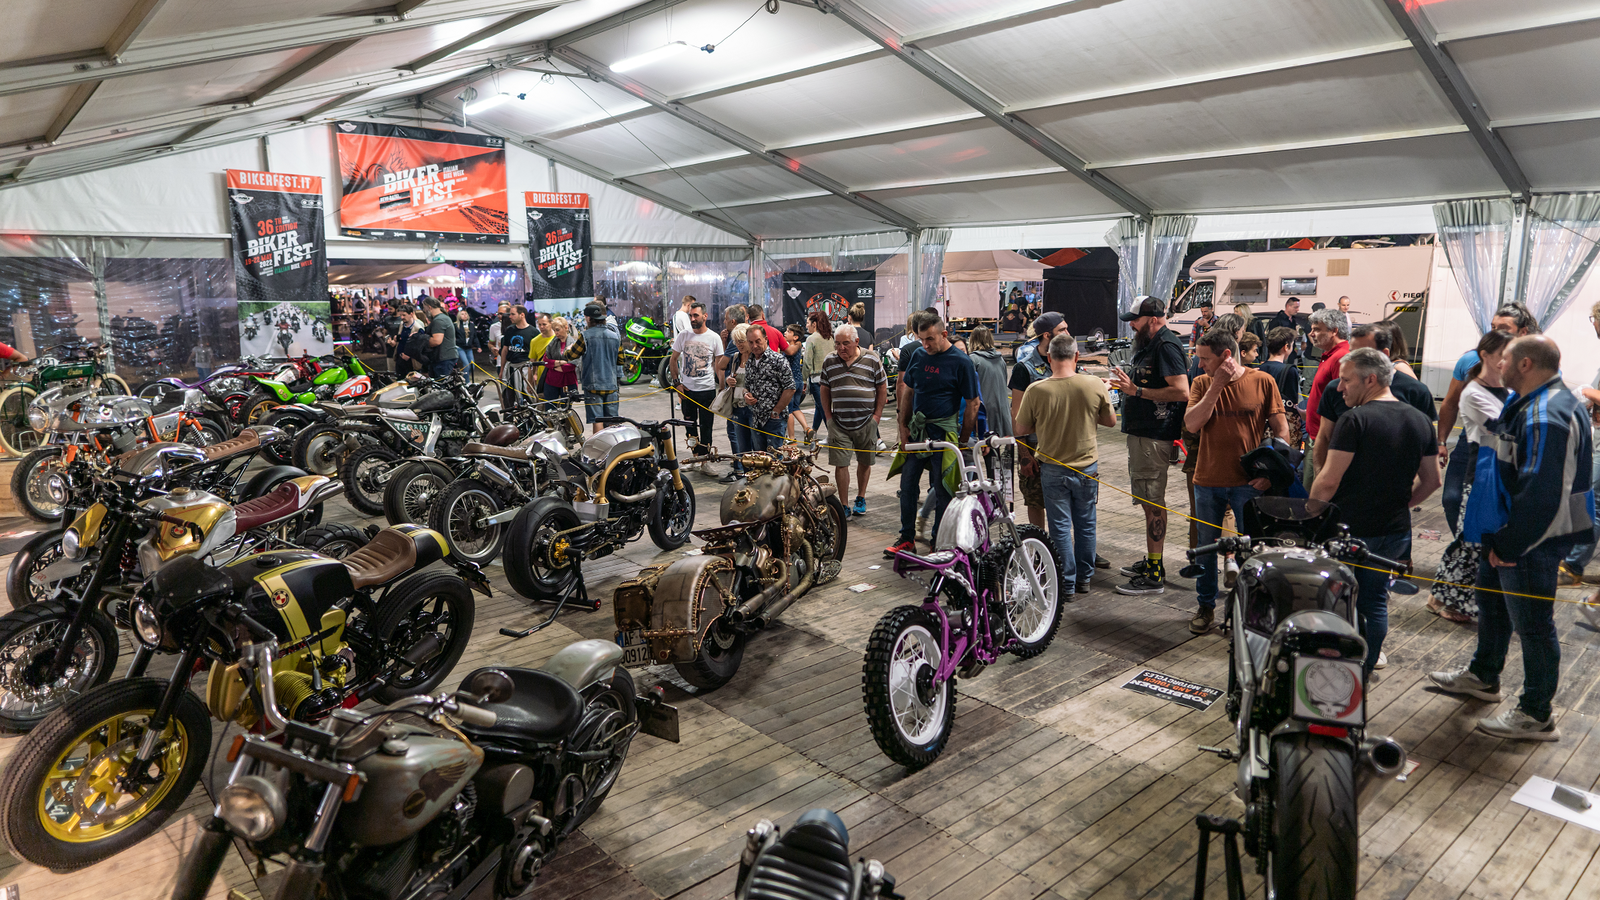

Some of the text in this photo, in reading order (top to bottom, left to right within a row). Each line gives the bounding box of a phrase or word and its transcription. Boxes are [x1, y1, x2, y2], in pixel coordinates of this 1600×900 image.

[239, 171, 311, 189] BIKERFEST.IT
[383, 164, 440, 194] BIKER
[412, 179, 456, 207] FEST
[533, 193, 581, 204] BIKERFEST.IT
[257, 219, 274, 236] 36
[275, 222, 298, 233] EDITION
[247, 230, 299, 257] BIKER
[545, 231, 557, 245] 36
[272, 242, 314, 267] FEST
[539, 239, 573, 264] BIKER
[556, 249, 583, 271] FEST
[259, 259, 273, 268] 2022
[924, 365, 940, 374] USA
[349, 384, 363, 395] 70
[624, 630, 634, 647] AF
[1143, 676, 1171, 688] TOUCH
[1143, 672, 1219, 695] THE MOTORCYCLES
[1172, 685, 1192, 693] AND
[1129, 679, 1212, 706] FORBIDDEN
